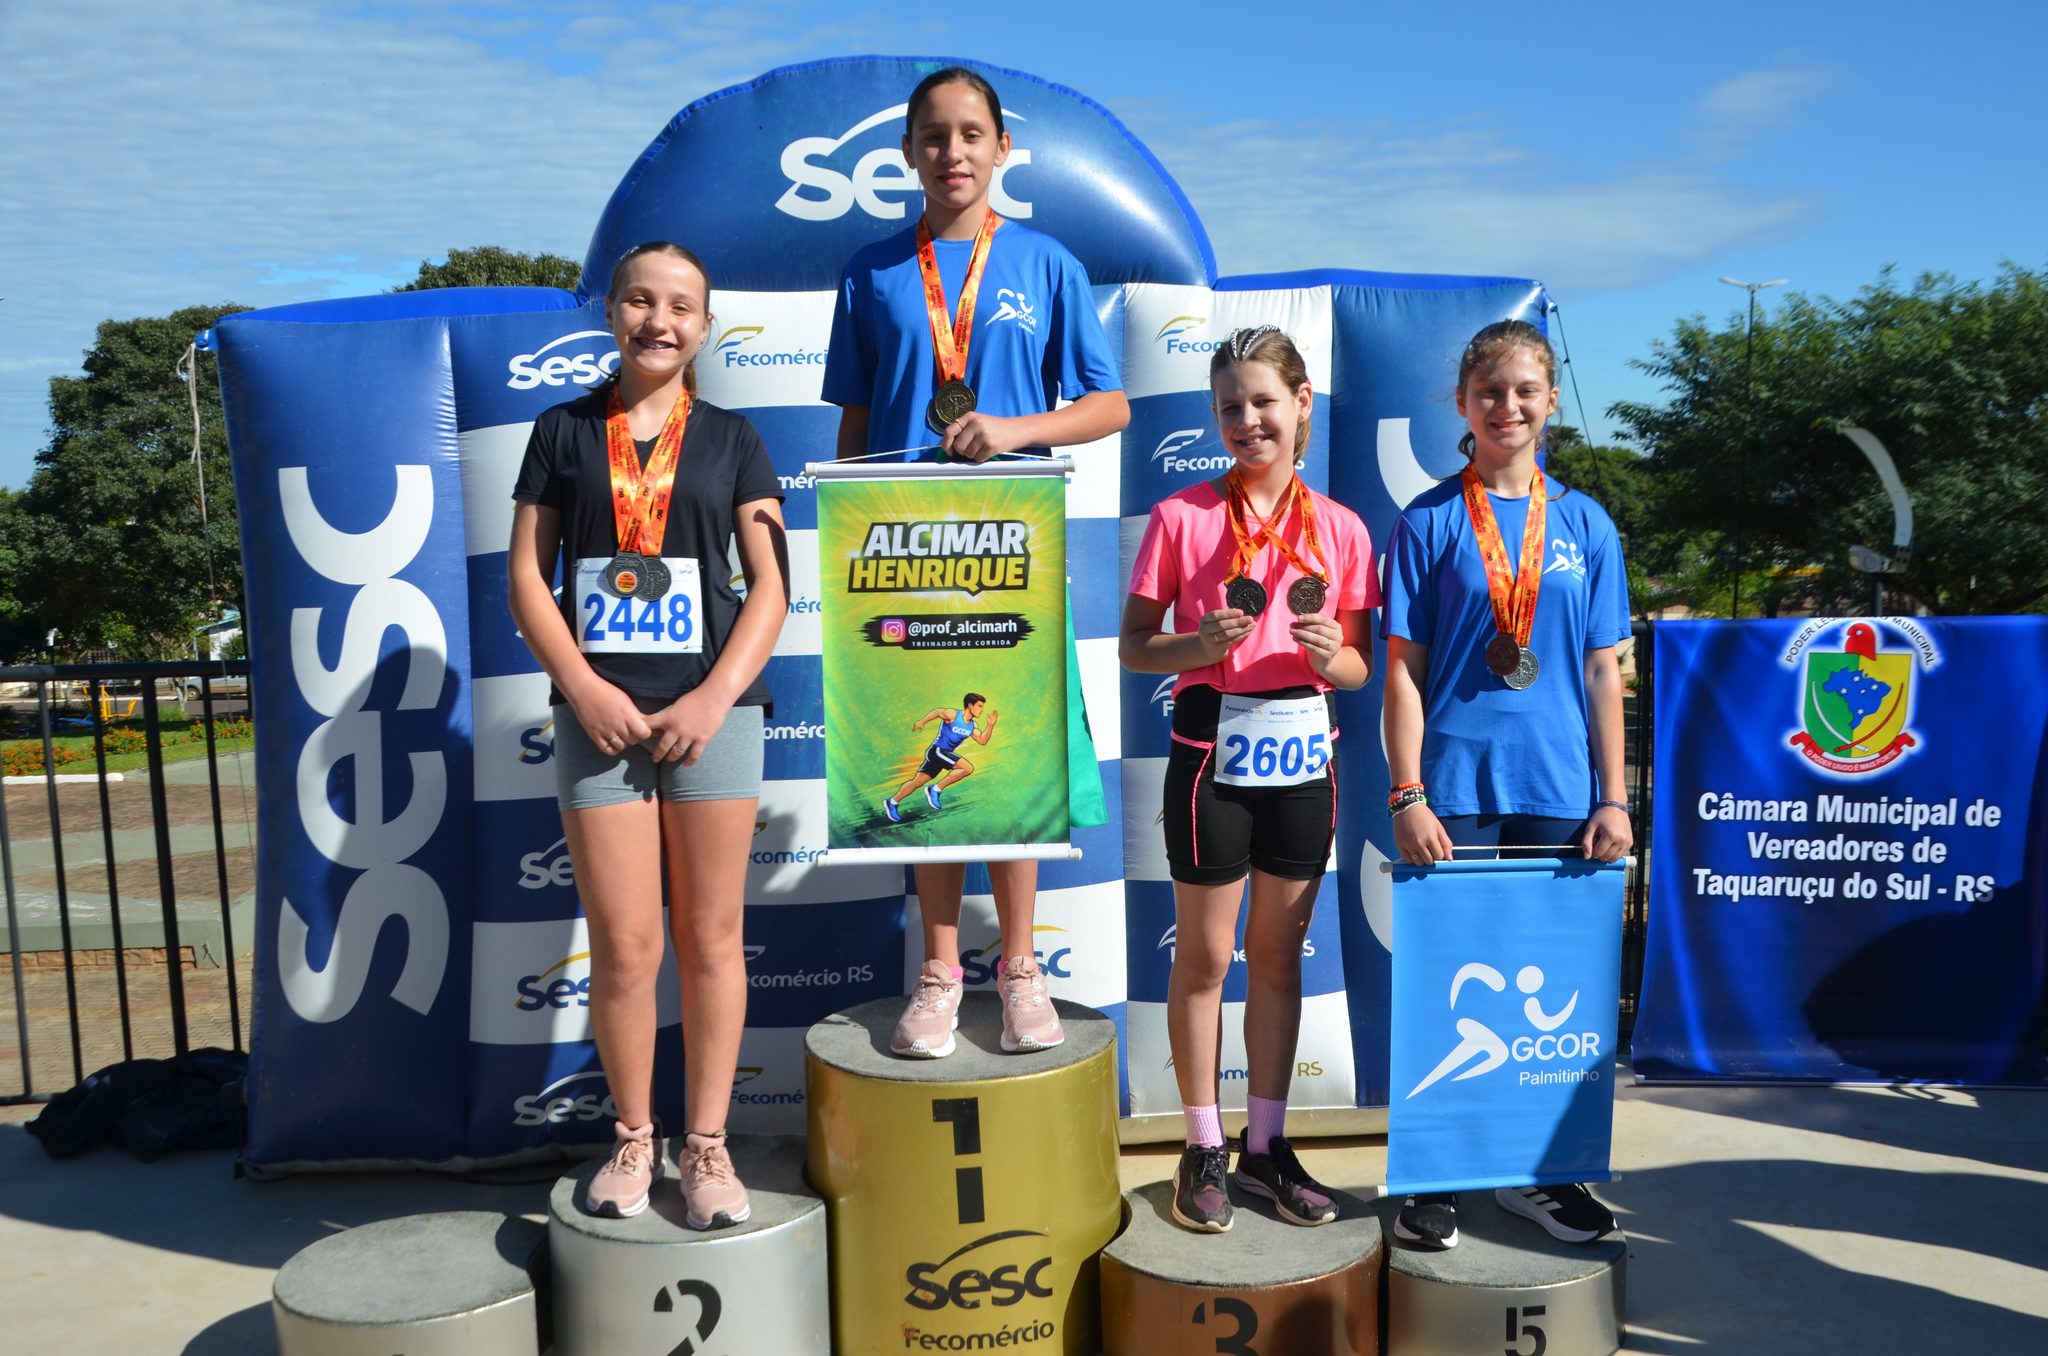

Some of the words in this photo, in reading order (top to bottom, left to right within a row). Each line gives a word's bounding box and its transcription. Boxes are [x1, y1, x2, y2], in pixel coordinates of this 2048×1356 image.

[775, 137, 1032, 221] Sec
[725, 349, 829, 368] Fecomérci
[1164, 456, 1237, 473] Fecom
[864, 523, 1025, 557] ALCIMAR
[852, 557, 1025, 592] HENRIQUE
[584, 593, 693, 642] 2448
[908, 620, 1017, 637] @prof_alcimarh
[1785, 628, 1815, 663] PODER
[1892, 617, 1935, 666] MUNICIPAL
[1223, 733, 1328, 777] 2605
[1811, 753, 1832, 767] PODER
[1832, 761, 1853, 771] UNIDO
[1698, 792, 1808, 822] Câmara
[1816, 794, 1957, 831] Municipal
[1965, 798, 2001, 827] de
[1747, 832, 1904, 862] Vereadores
[1912, 836, 1947, 863] de
[518, 852, 574, 889] Se
[1693, 868, 1834, 904] Taquaruçu
[1842, 872, 1877, 899] do
[1886, 872, 1930, 900] Sul
[1937, 887, 1947, 895] -
[1954, 875, 1996, 902] RS
[1301, 939, 1316, 957] S
[514, 975, 590, 1011] Ses
[747, 969, 841, 987] comércio
[848, 965, 874, 983] RS
[1512, 1032, 1600, 1062] GCOR
[1297, 1060, 1324, 1077] RS
[1519, 1068, 1600, 1086] Palmitinho
[932, 1097, 985, 1224] 1
[654, 1279, 722, 1356] 2
[1192, 1297, 1258, 1356] 3
[1504, 1305, 1547, 1356] 5
[905, 1320, 1054, 1352] Fecomércio
